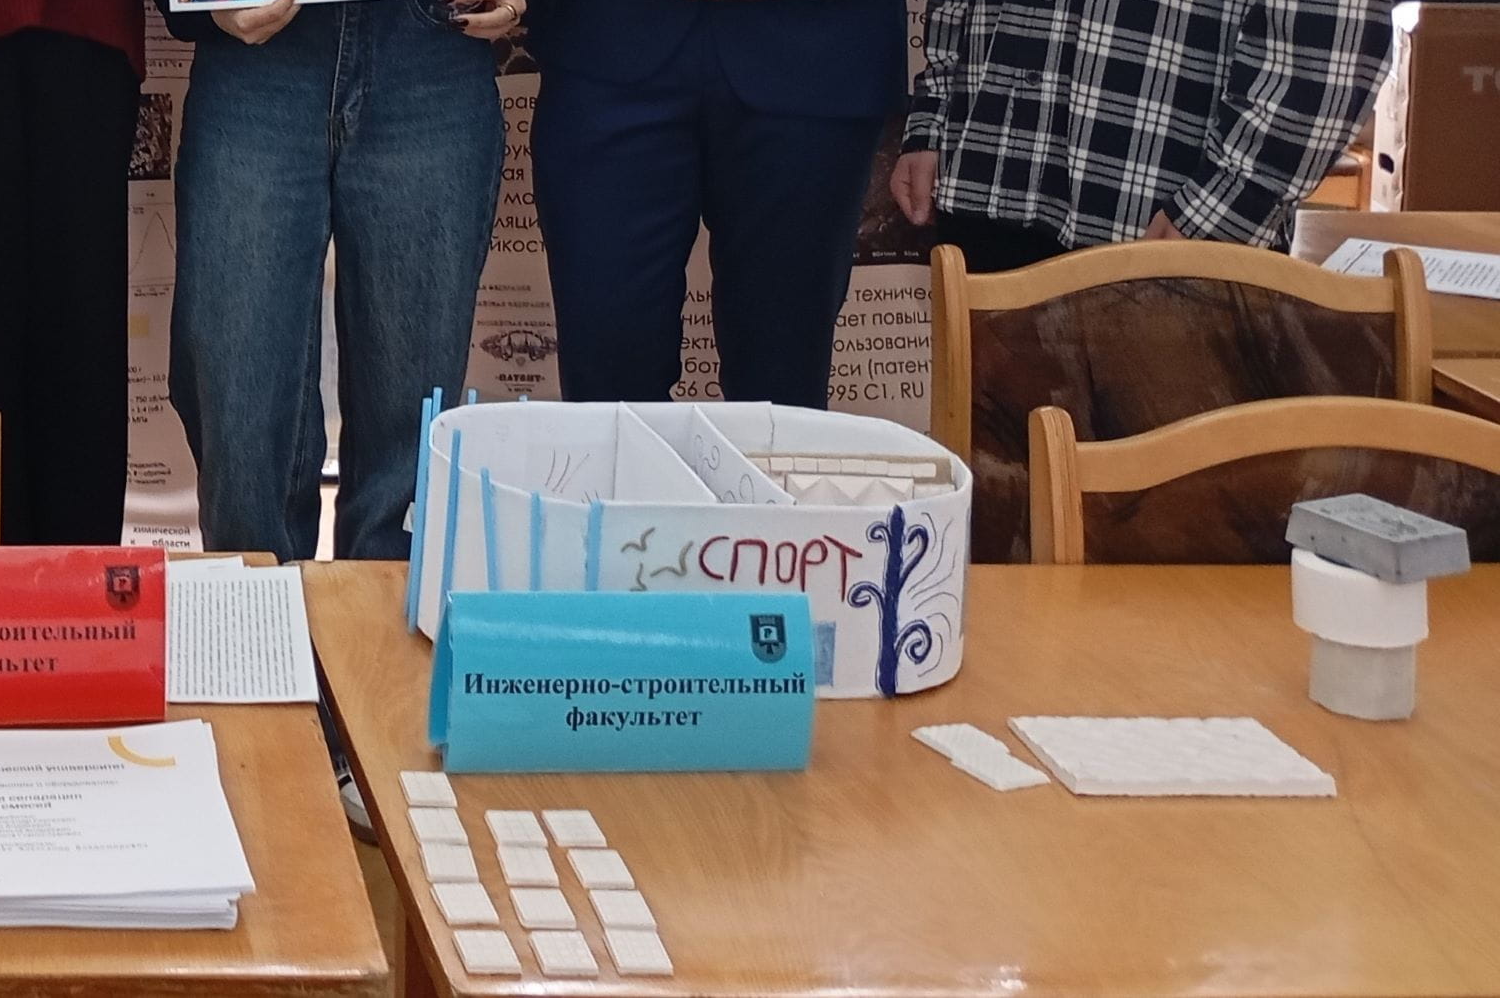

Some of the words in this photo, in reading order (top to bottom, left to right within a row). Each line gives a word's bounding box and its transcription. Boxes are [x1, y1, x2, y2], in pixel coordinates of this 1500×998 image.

[900, 381, 925, 399] RU
[133, 525, 191, 536] химической
[151, 538, 191, 549] области
[698, 534, 863, 603] СПОРТ
[463, 672, 806, 700] Инженерно-строительный
[565, 704, 703, 731] факультет
